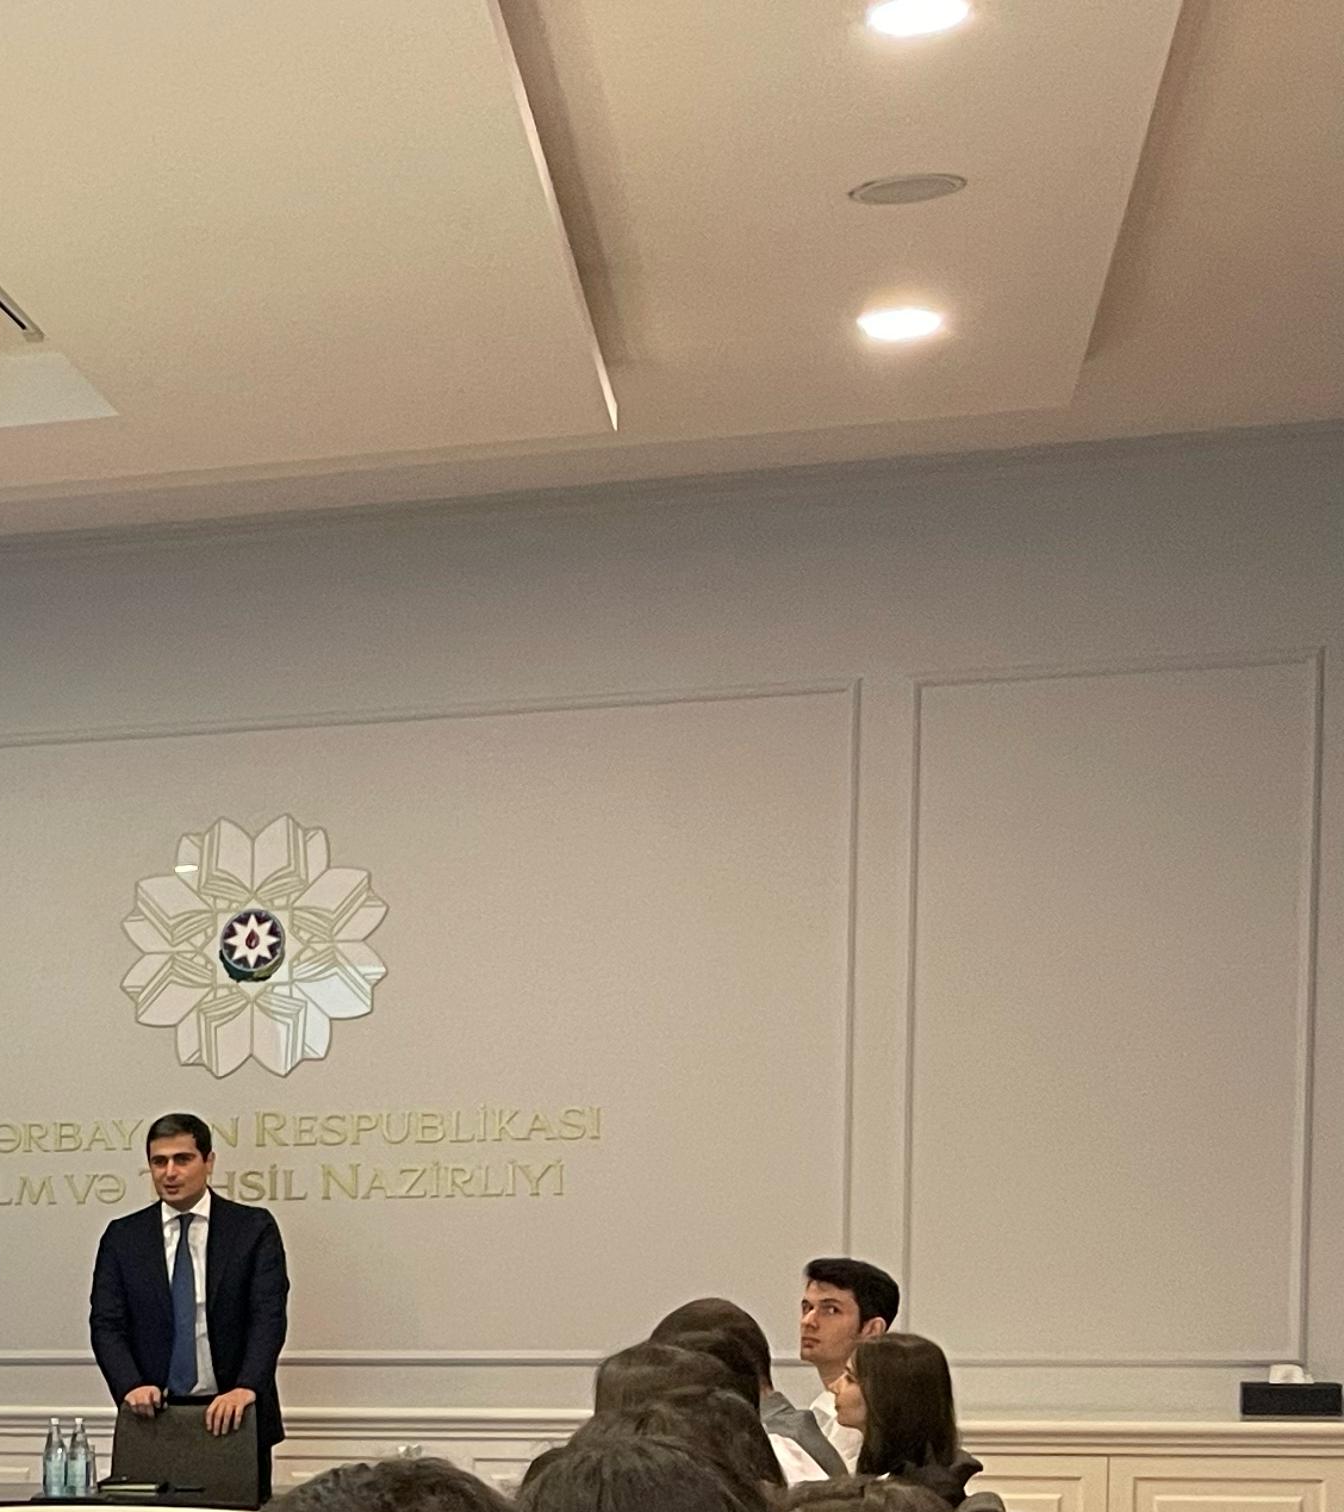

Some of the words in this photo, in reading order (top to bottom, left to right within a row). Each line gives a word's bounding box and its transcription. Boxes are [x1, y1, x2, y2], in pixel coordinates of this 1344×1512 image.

[255, 1103, 602, 1148] RESPUBLİKASI
[64, 1173, 127, 1206] VƏ
[321, 1159, 566, 1200] NAZİRLİYİ
